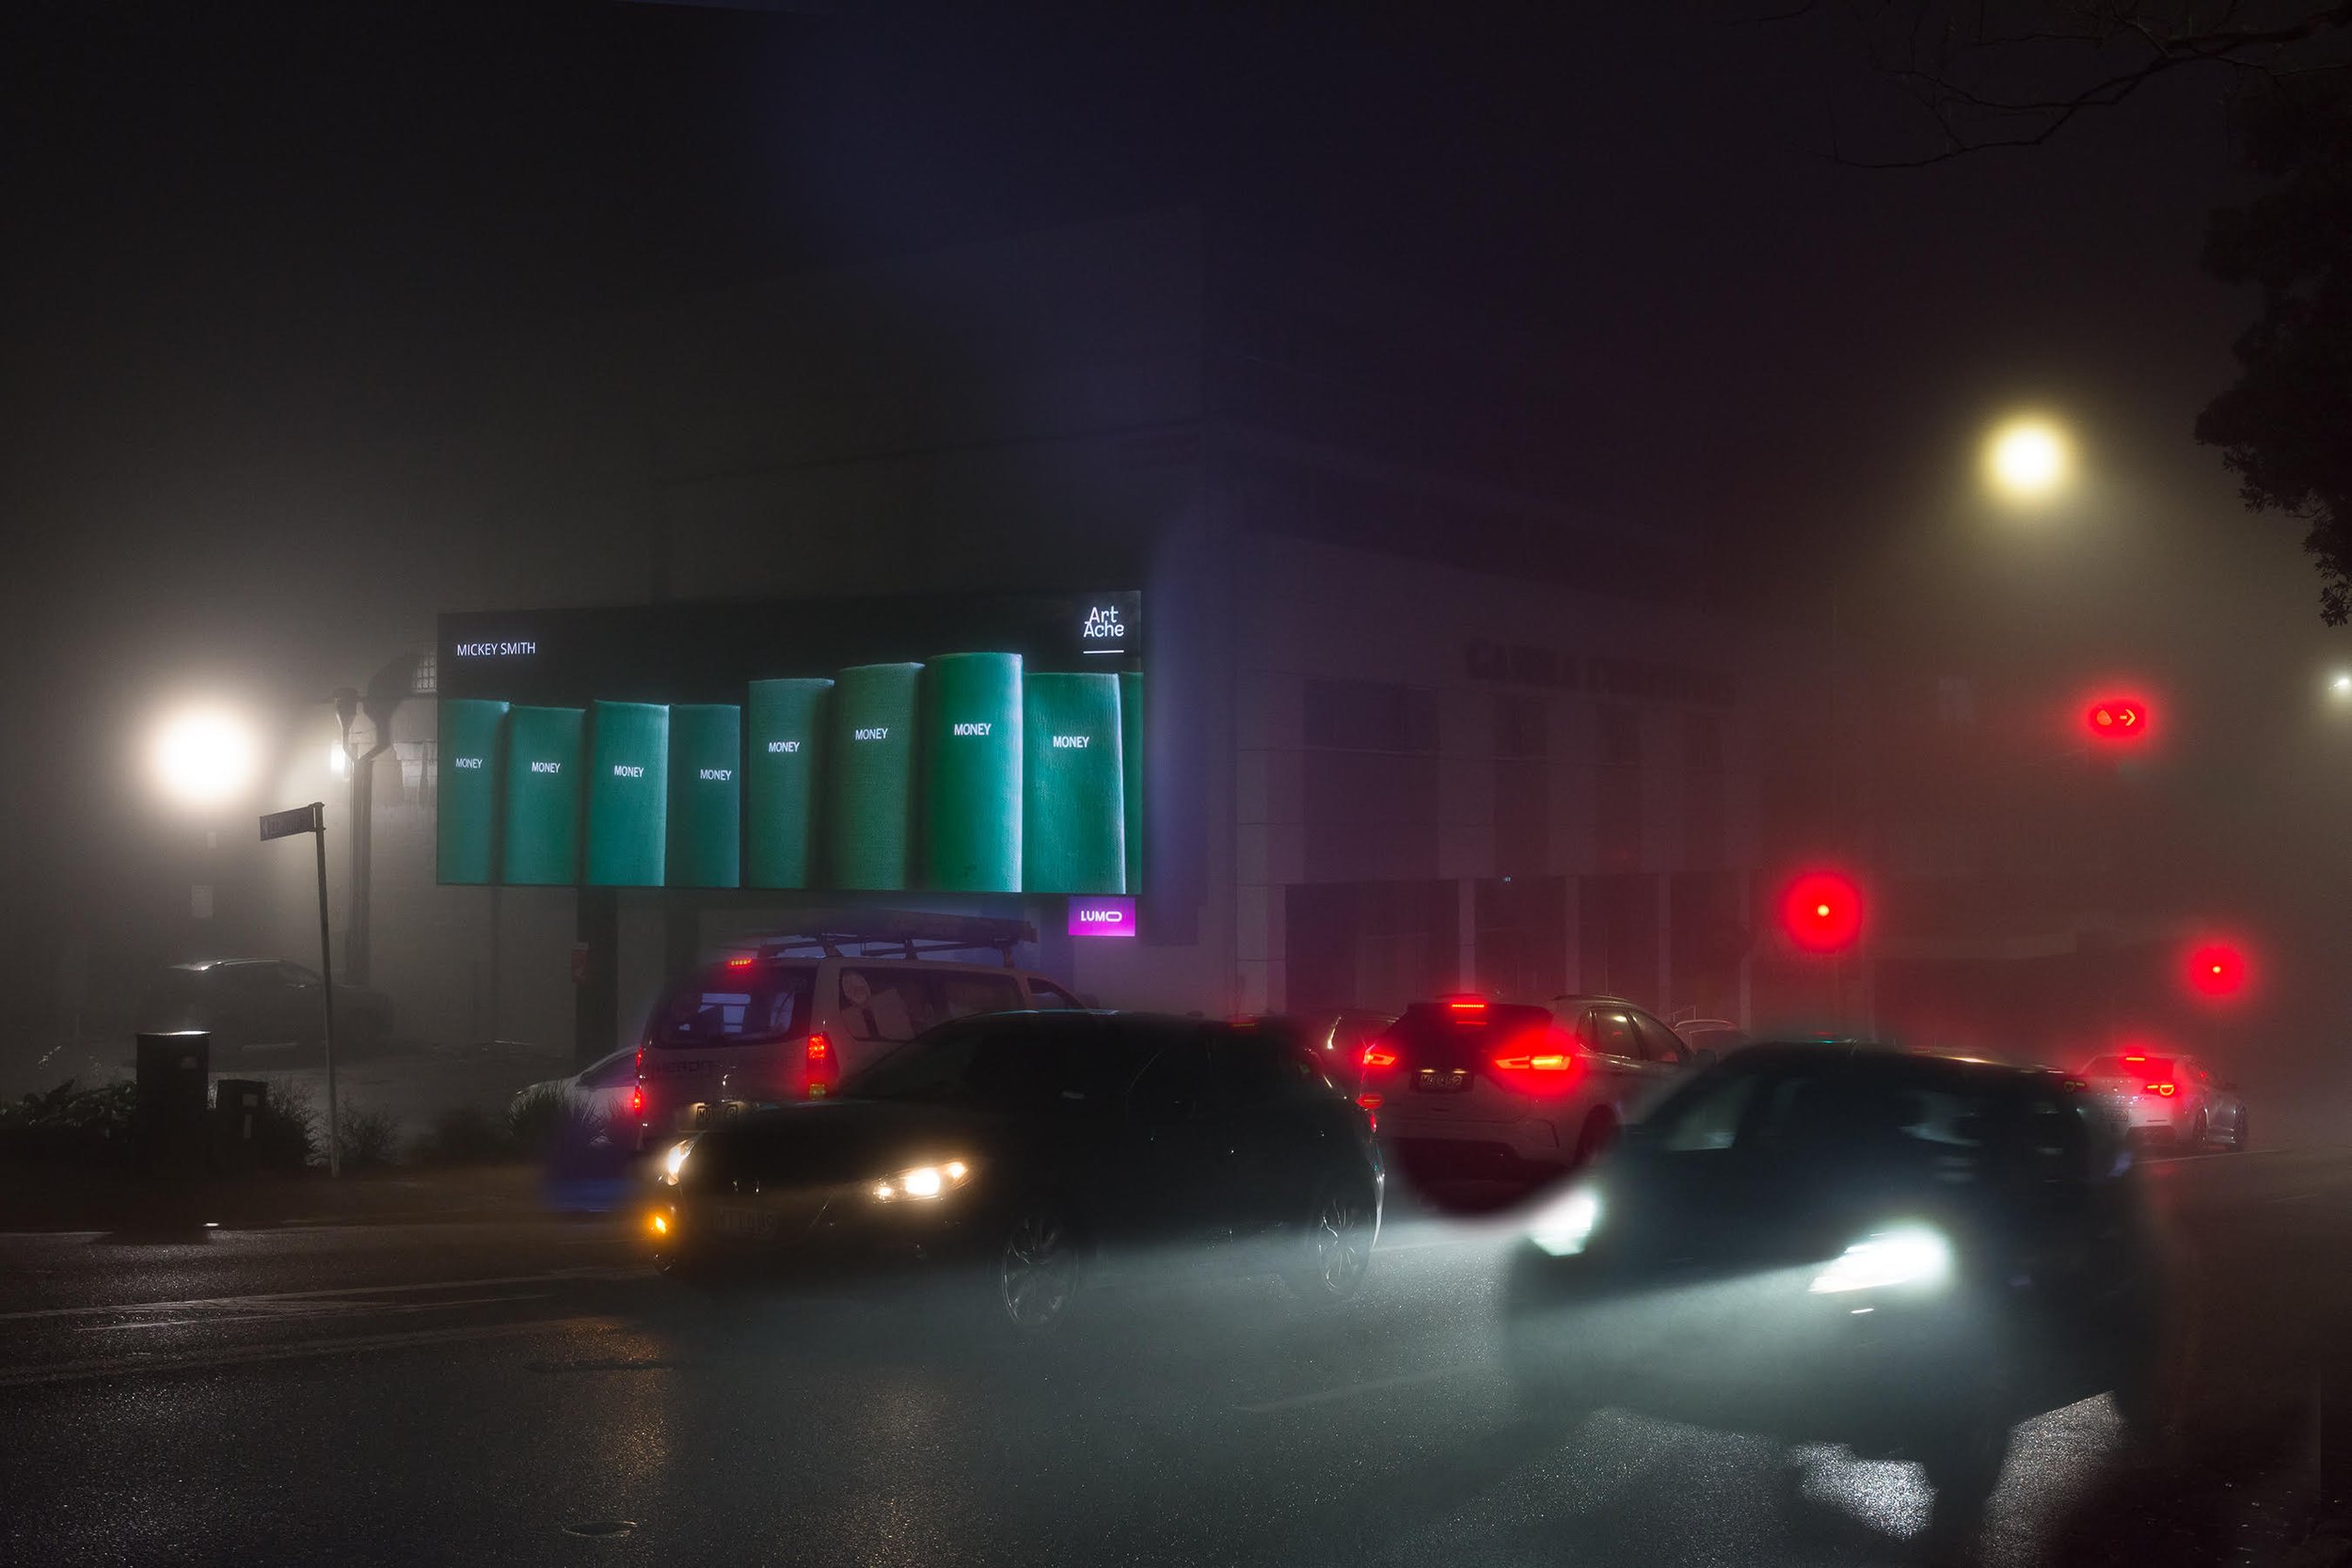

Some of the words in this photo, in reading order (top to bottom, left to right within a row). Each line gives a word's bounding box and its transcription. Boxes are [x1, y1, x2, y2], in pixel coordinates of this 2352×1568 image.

[1085, 606, 1119, 623] Art
[1084, 621, 1124, 638] Ache
[456, 643, 498, 657] MICKEY
[501, 641, 536, 656] SMITH
[855, 728, 888, 740] MONEY
[953, 723, 992, 736] MONEY
[768, 741, 801, 752] MONEY
[1053, 736, 1090, 749] MONEY
[455, 758, 483, 768] MONEY
[531, 762, 561, 773] MONEY
[613, 766, 644, 777] MONEY
[700, 769, 732, 781] MONEY
